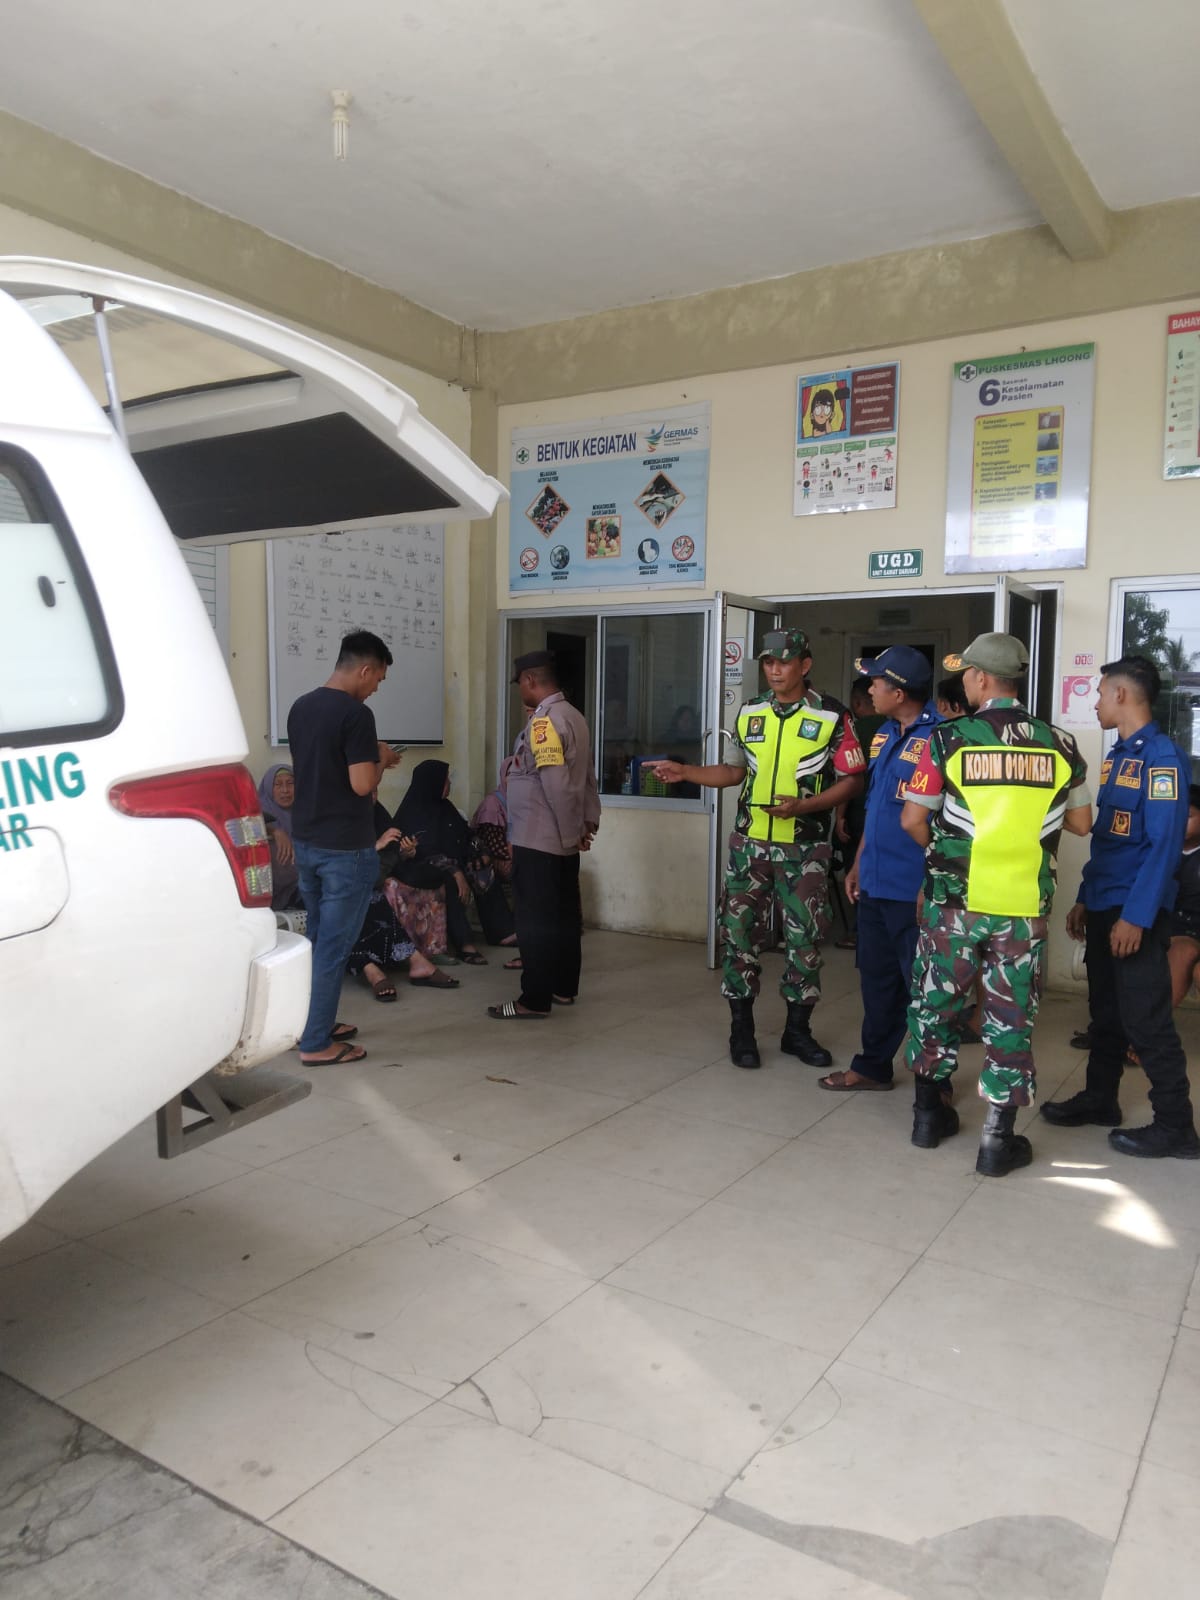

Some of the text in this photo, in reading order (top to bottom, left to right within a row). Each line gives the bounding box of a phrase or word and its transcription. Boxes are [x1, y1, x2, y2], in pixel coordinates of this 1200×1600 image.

[978, 352, 1091, 375] PUSKESMAS LHOONG
[978, 379, 1001, 406] 6
[1001, 380, 1064, 394] Keselamatan
[1001, 391, 1033, 402] Pasien
[663, 426, 699, 439] GERMAS
[537, 431, 637, 462] BENTUK KEGIATAN
[878, 552, 915, 568] UGD
[965, 753, 1054, 782] KODIM 0101/KBA
[0, 751, 86, 810] ING
